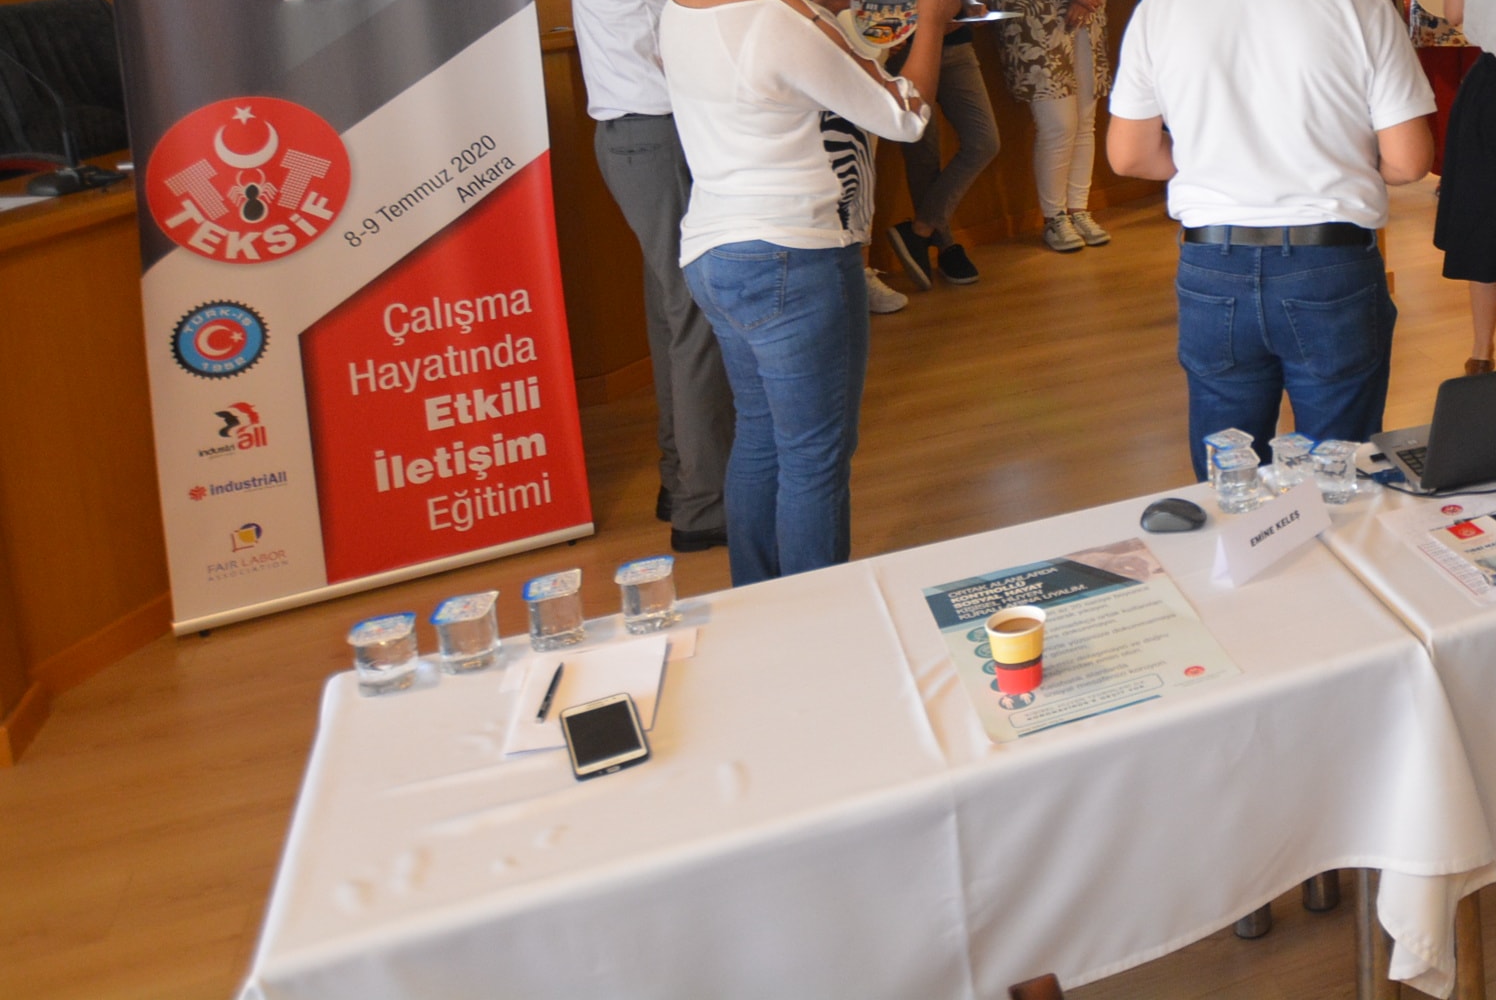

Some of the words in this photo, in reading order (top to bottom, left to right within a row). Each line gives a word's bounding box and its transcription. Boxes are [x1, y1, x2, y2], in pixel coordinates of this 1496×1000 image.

[344, 218, 380, 247] 8-9
[375, 168, 454, 222] Temmuz
[450, 135, 496, 173] 2020
[456, 156, 516, 203] Ankara
[383, 288, 532, 346] Çalışma
[348, 333, 537, 396] Hayatında
[424, 376, 541, 431] Etkili
[209, 471, 288, 496] industriAll
[374, 432, 547, 492] İletişim
[427, 472, 551, 532] Eğitimi
[207, 560, 239, 574] FAIR
[241, 549, 287, 567] LABOR
[948, 585, 988, 598] ORTAK
[989, 567, 1058, 588] ALANLARDA
[950, 580, 1027, 604] KONTROLLÜ
[953, 593, 1002, 609] SOSYAL
[1004, 582, 1044, 597] HAYAT
